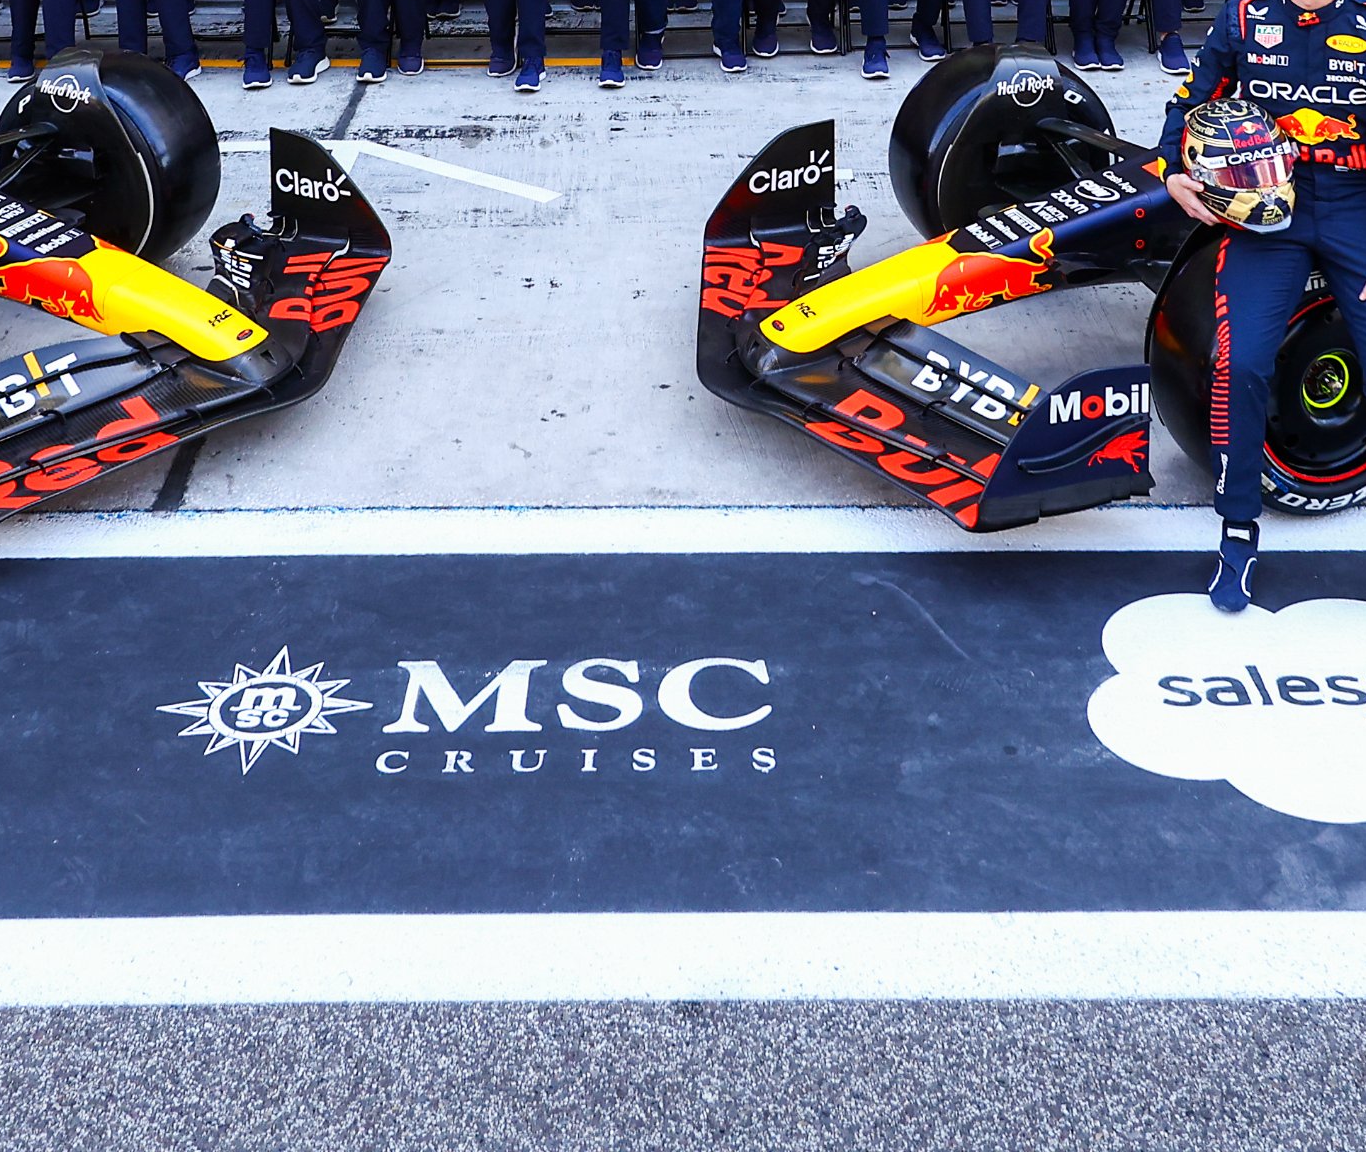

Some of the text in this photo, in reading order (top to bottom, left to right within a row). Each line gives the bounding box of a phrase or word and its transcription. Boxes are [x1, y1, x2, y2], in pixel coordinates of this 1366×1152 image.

[1247, 53, 1277, 66] Mobil
[1328, 58, 1366, 75] BYBIT
[1227, 144, 1284, 165] ORACLE
[276, 167, 339, 203] Claro
[748, 161, 822, 195] Claro
[911, 350, 1040, 426] BYBI
[1049, 383, 1150, 425] Mobil
[385, 657, 774, 734] MSC
[375, 747, 778, 774] CRUISES
